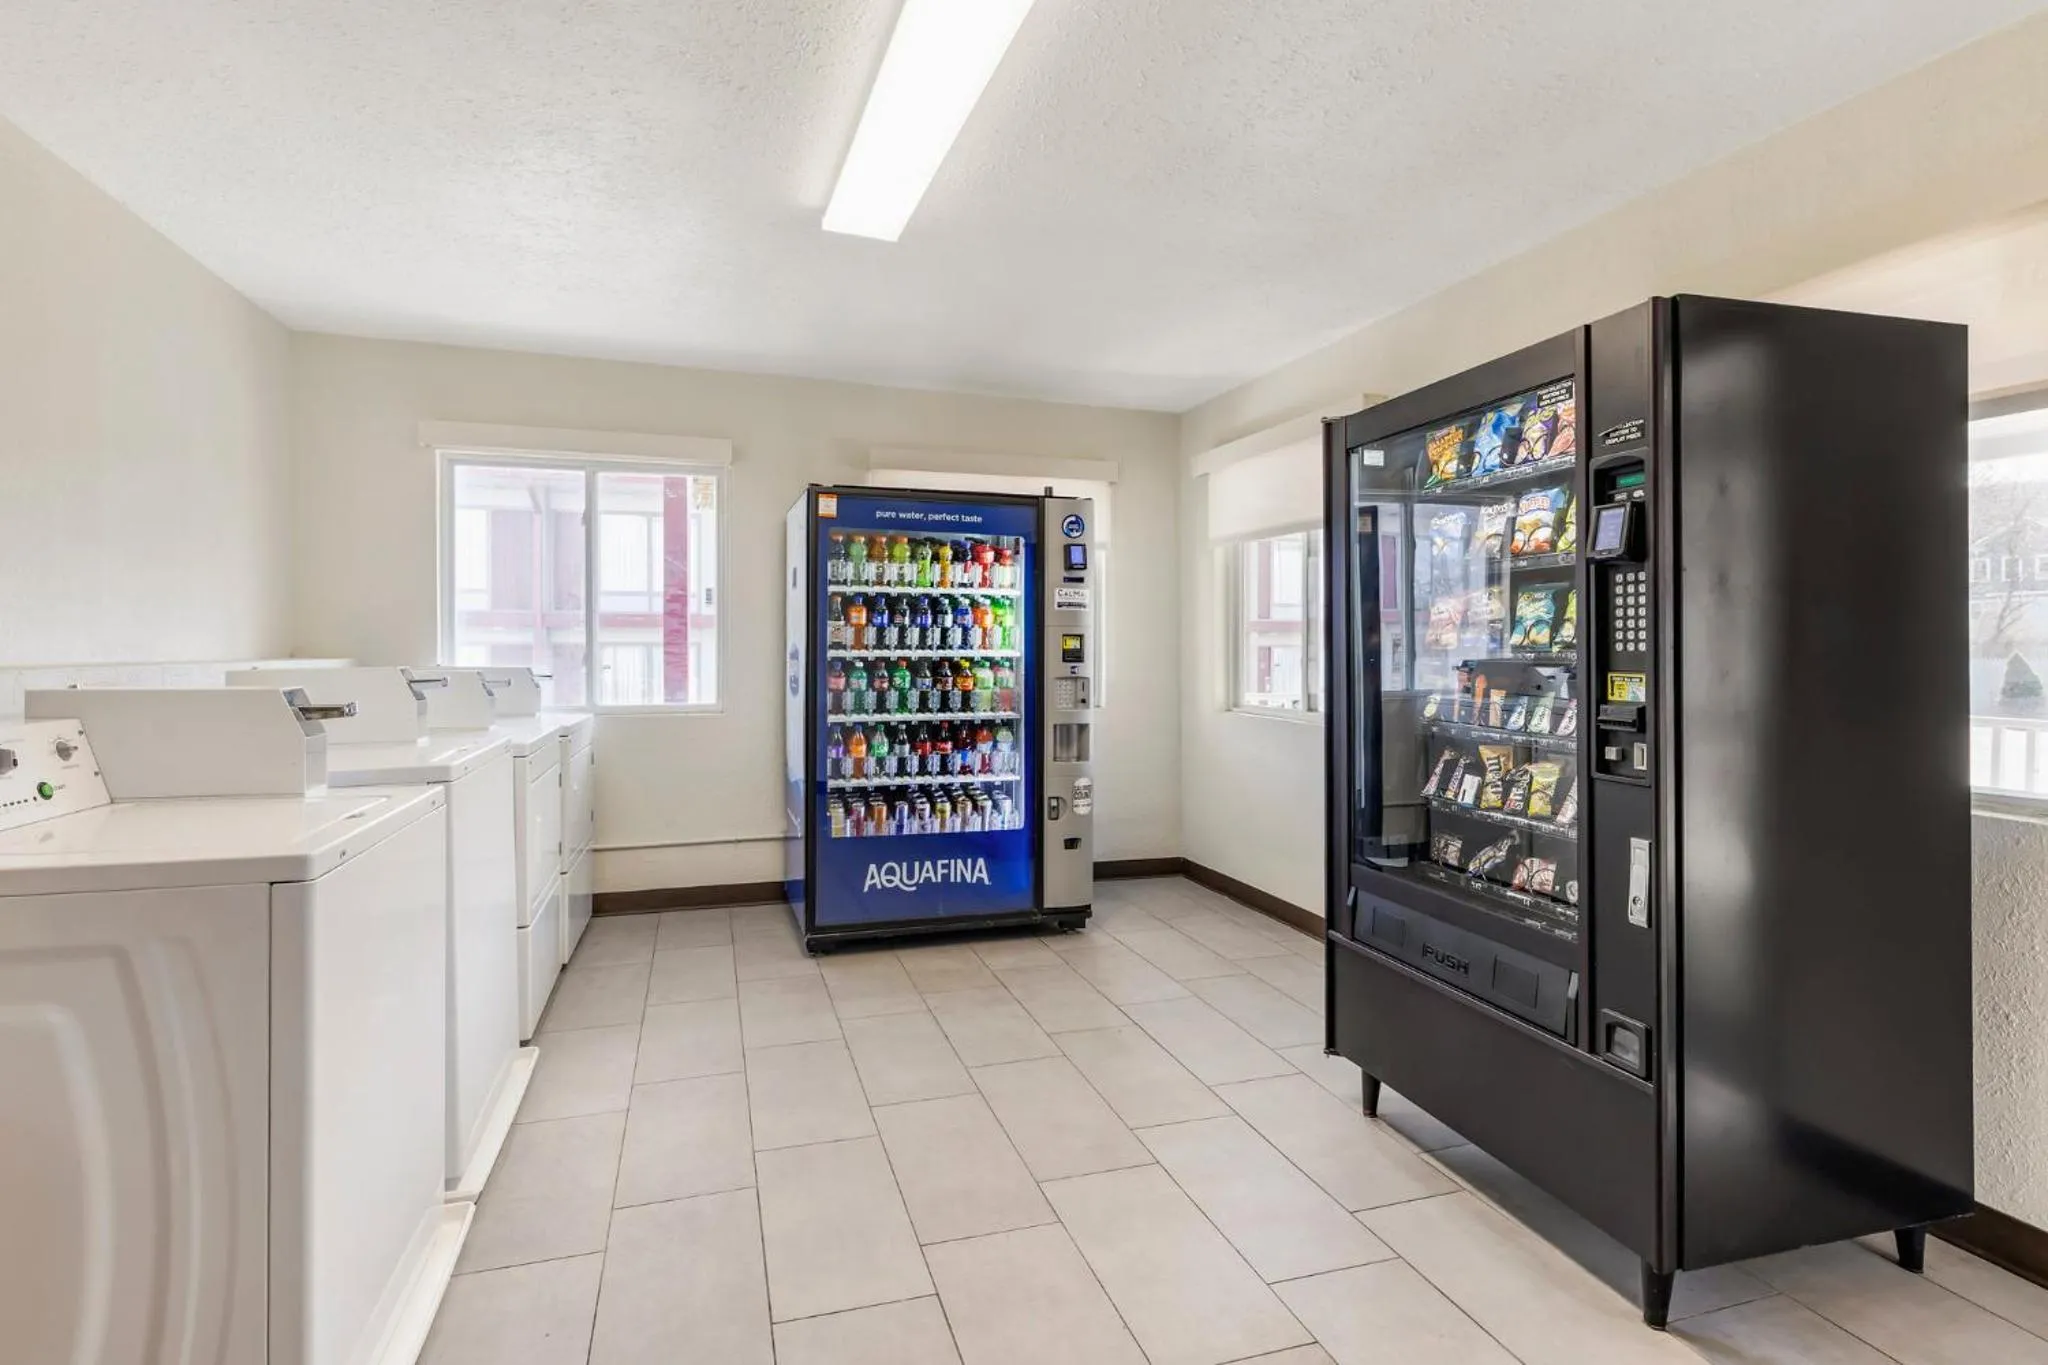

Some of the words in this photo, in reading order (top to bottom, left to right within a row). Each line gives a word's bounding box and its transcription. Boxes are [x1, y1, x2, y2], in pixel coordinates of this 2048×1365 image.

[875, 509, 897, 519] pure
[899, 511, 927, 521] water,
[928, 512, 960, 523] perfect
[961, 514, 983, 523] taste
[863, 857, 992, 893] AQUAFINA
[1422, 942, 1470, 975] PUSH
